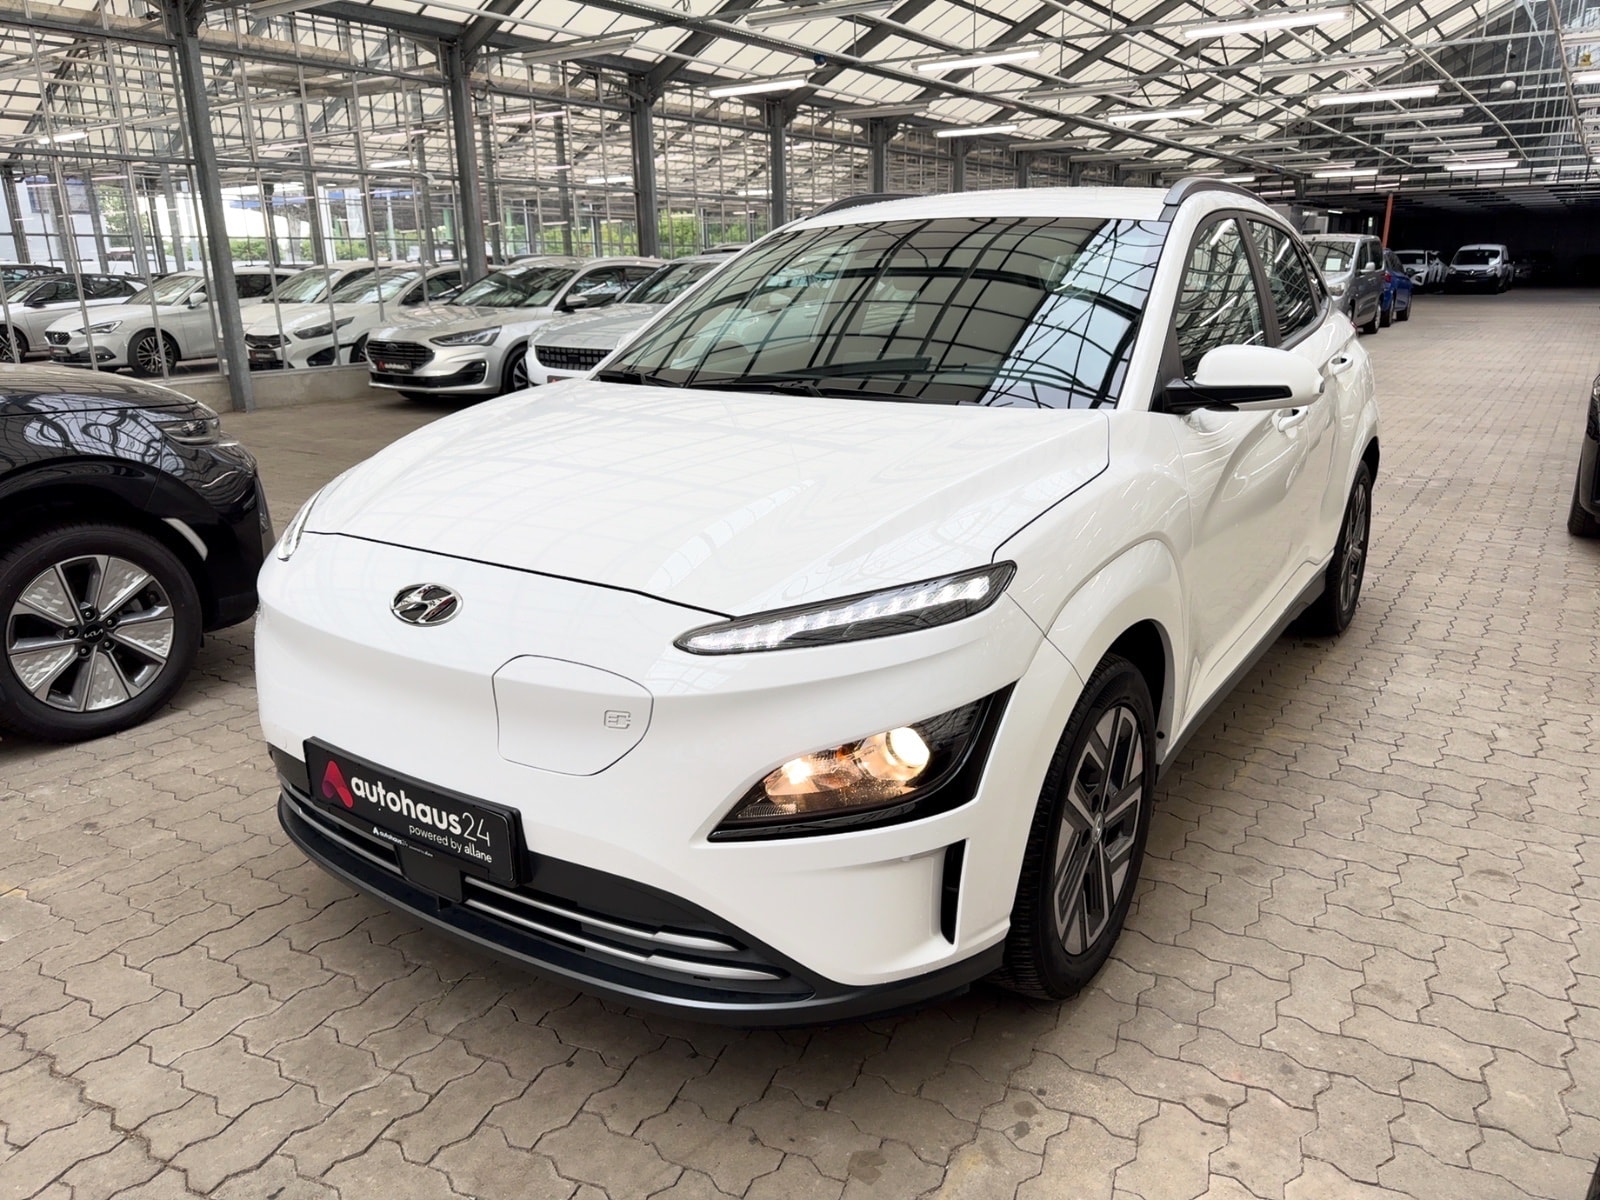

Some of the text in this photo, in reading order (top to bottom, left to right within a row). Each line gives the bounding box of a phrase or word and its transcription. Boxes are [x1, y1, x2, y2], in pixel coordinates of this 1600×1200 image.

[351, 777, 490, 847] autohaus24
[408, 824, 449, 846] powered
[450, 837, 463, 854] by
[464, 841, 493, 863] allane
